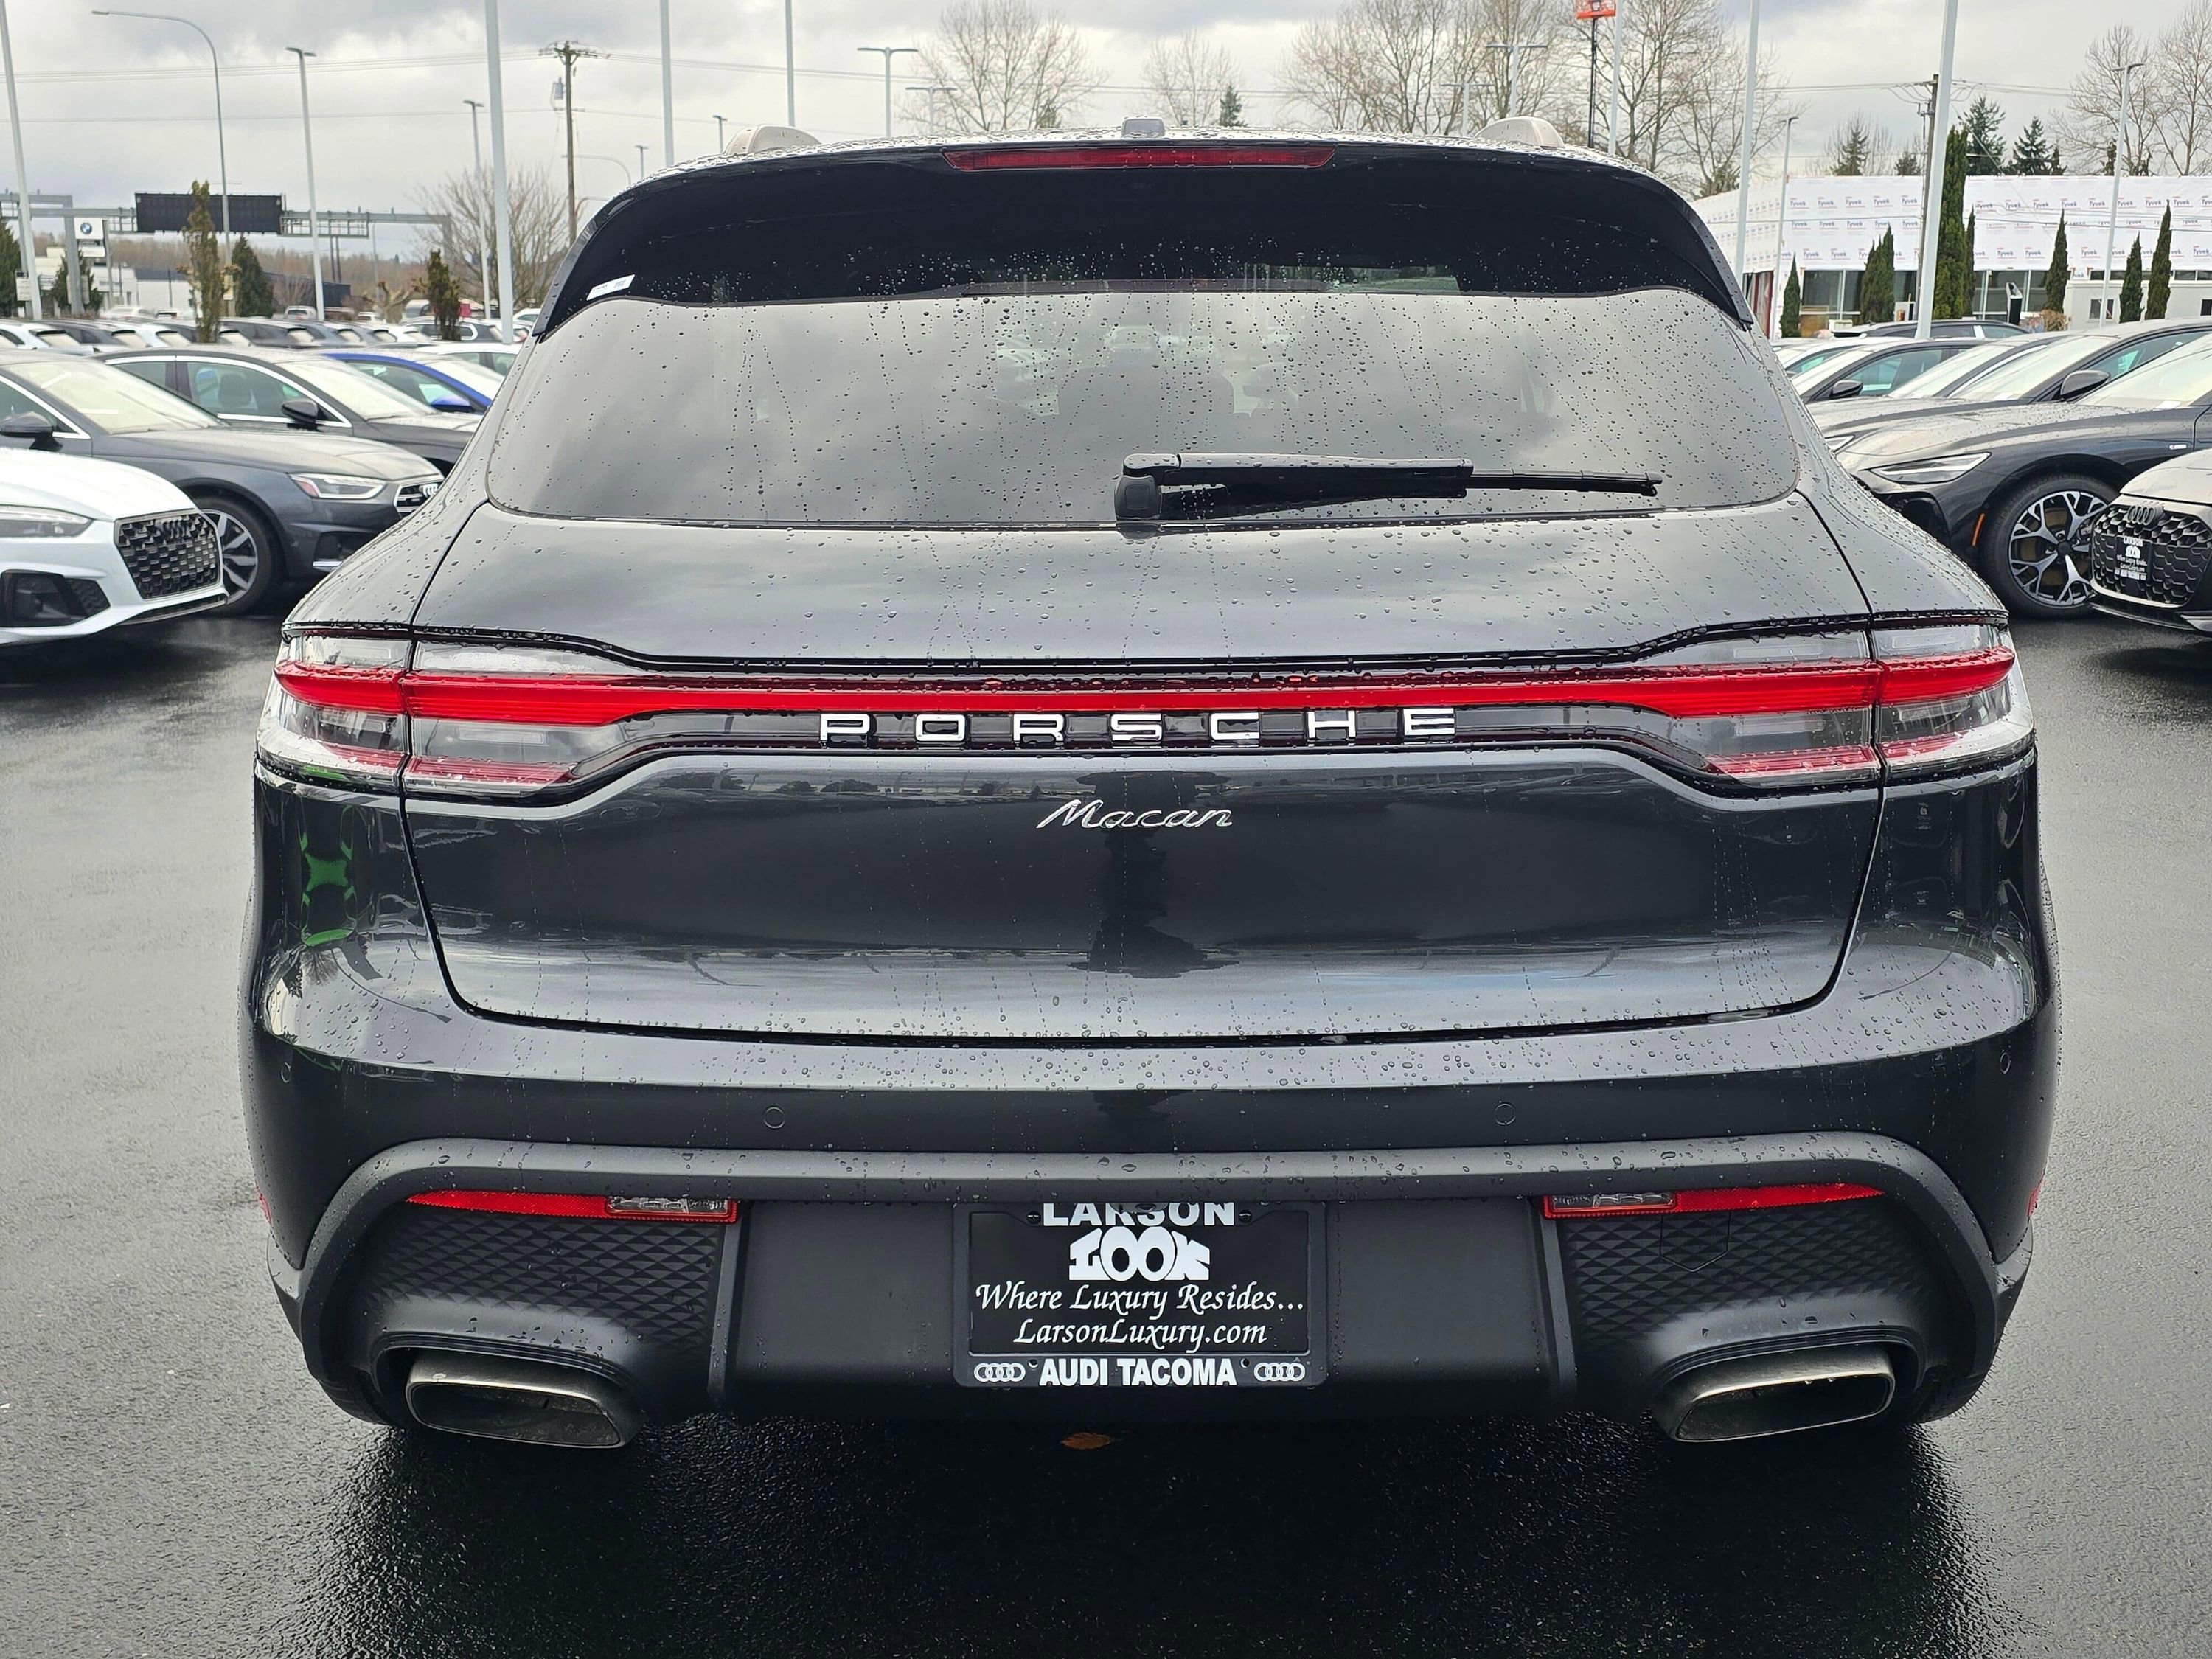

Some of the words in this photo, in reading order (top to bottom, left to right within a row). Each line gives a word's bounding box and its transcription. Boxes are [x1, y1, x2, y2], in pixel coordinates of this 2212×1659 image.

[820, 706, 1457, 744] PORSCHE
[1036, 799, 1233, 830] Macan
[975, 1281, 1062, 1310] Where
[1069, 1284, 1168, 1320] Luxury
[1178, 1281, 1304, 1315] Resides...
[1013, 1318, 1267, 1353] LarsonLuxury.com
[1039, 1358, 1108, 1386] AUDI
[1116, 1358, 1237, 1387] TACOMA
